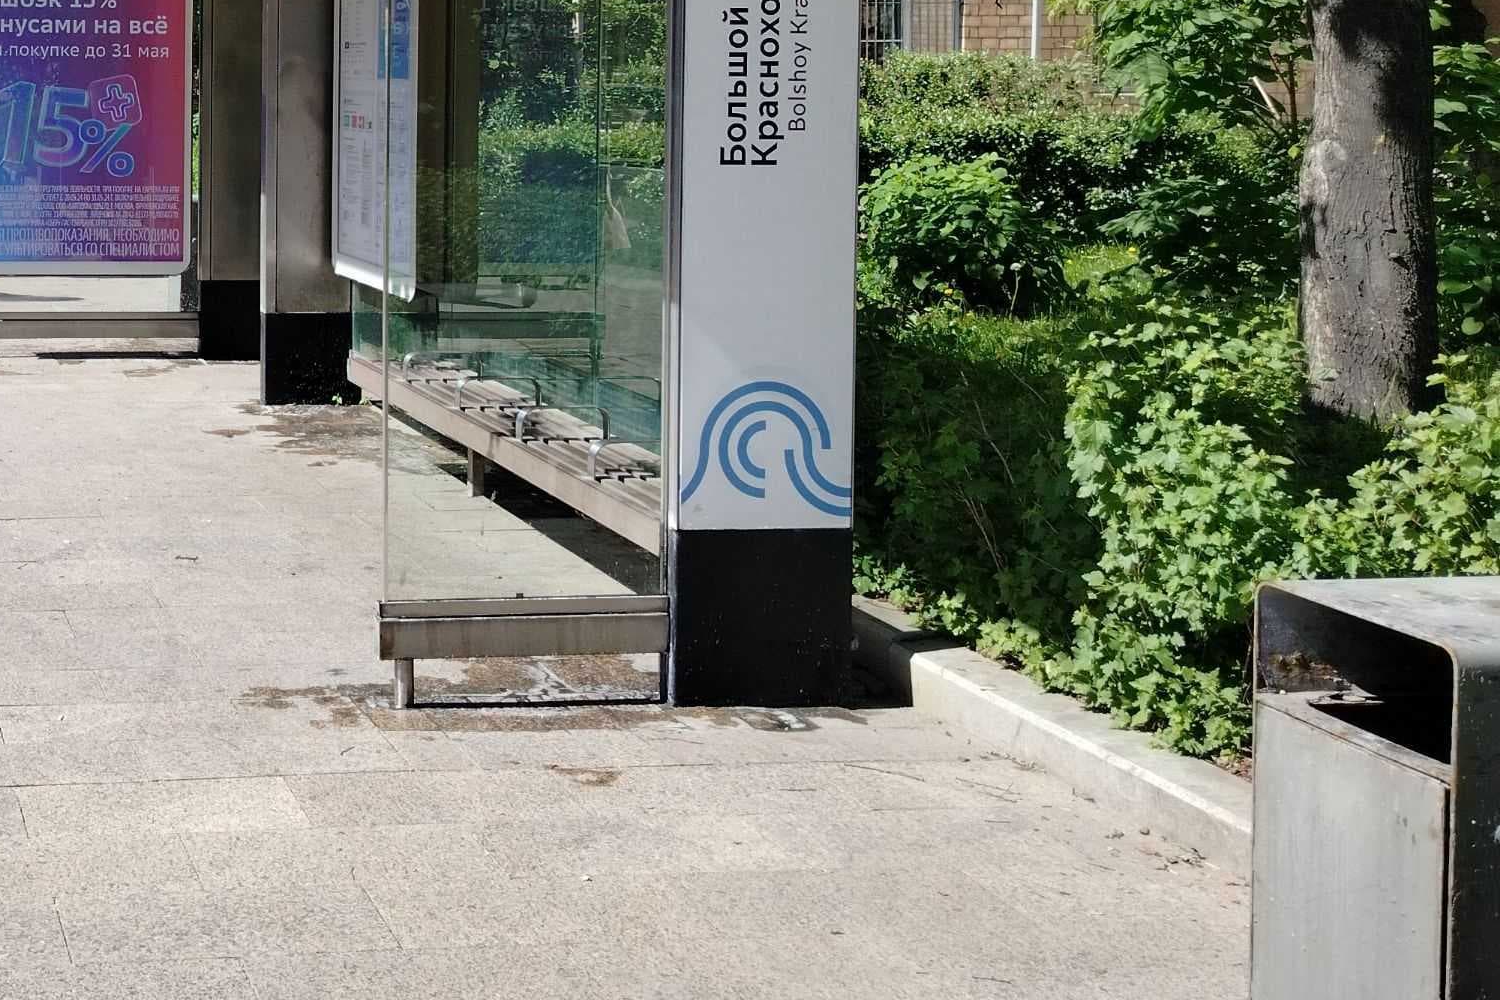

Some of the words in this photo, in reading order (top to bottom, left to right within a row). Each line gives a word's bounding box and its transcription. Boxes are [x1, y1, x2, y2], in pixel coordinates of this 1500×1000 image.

[94, 18, 121, 35] на
[129, 15, 169, 35] всё
[9, 43, 80, 60] покупке
[84, 44, 106, 60] до
[111, 43, 132, 57] 31
[138, 46, 170, 58] мая
[719, 7, 749, 166] Большой
[788, 41, 812, 131] Bolshoy
[84, 242, 98, 257] СО
